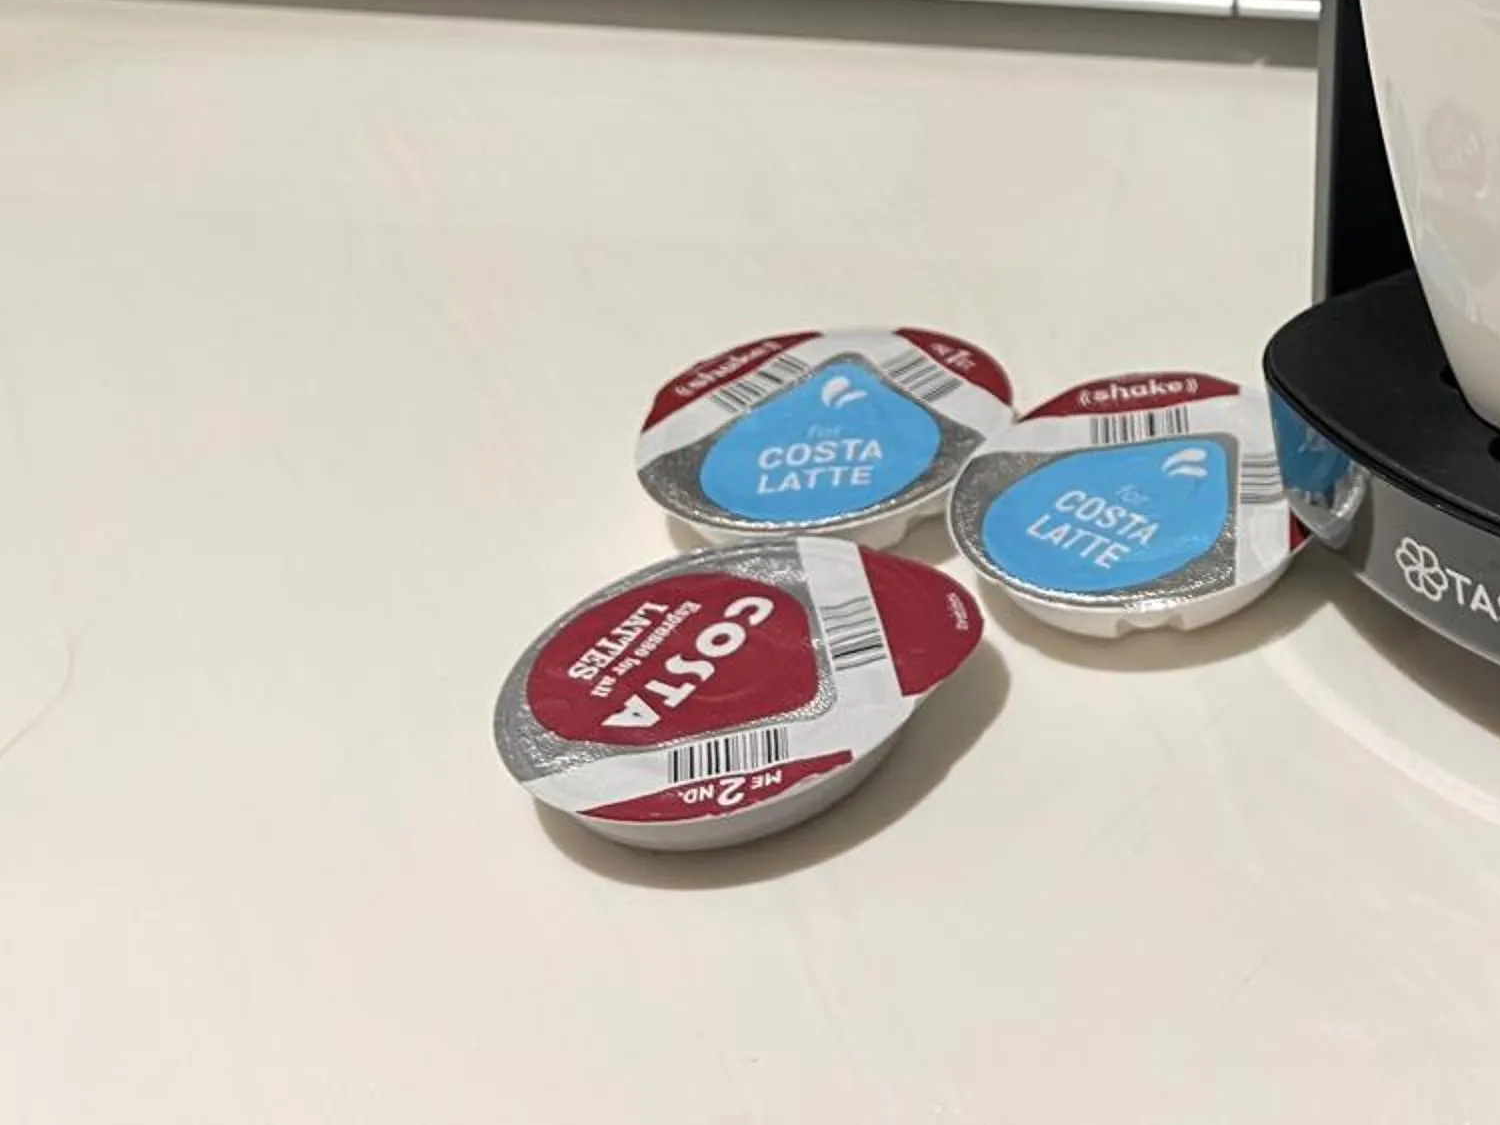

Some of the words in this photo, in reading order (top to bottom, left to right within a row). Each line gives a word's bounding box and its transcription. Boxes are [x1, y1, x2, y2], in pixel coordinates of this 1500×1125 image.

[758, 438, 883, 470] COSTA
[757, 465, 873, 495] LATTE
[1055, 490, 1159, 546] COSTA
[1026, 513, 1131, 571] LATTE
[569, 601, 669, 680] LATTES
[634, 600, 702, 658] Espresso
[601, 596, 775, 728] COSTA
[612, 656, 642, 676] for
[590, 674, 617, 698] all
[751, 770, 783, 790] ME
